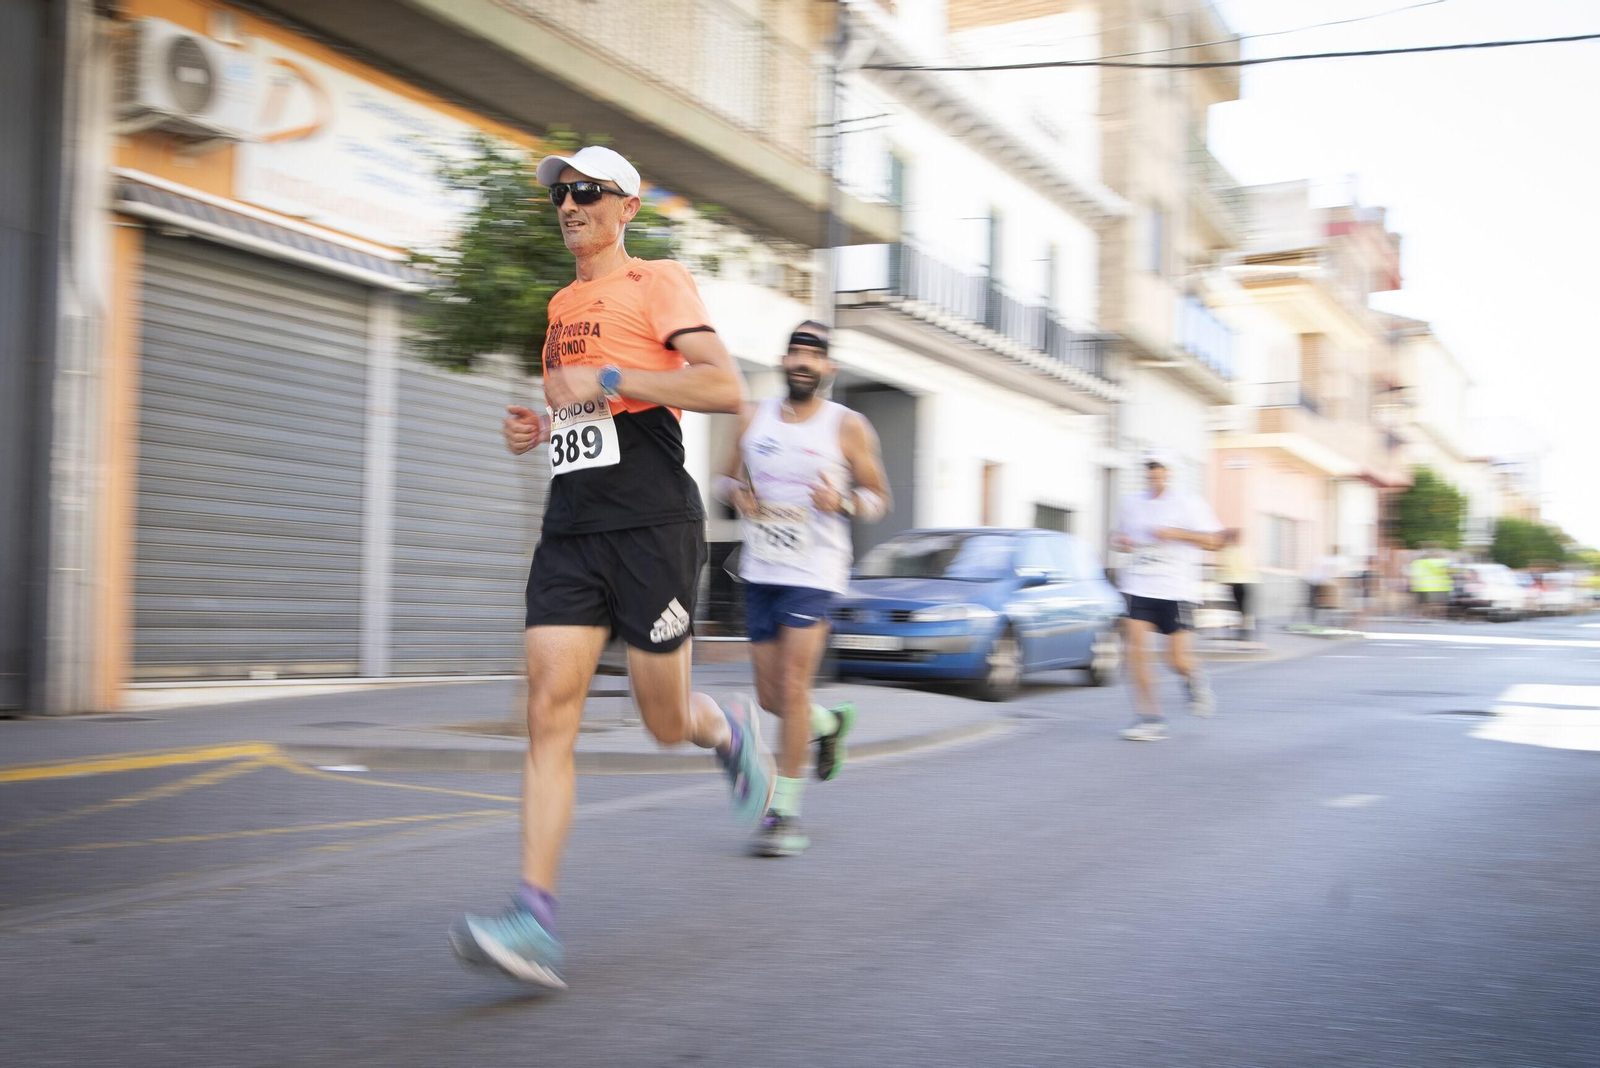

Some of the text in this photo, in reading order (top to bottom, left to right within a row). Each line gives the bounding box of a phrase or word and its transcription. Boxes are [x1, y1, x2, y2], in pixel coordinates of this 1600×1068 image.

[562, 321, 601, 338] PRUEBA
[556, 339, 586, 359] FONDO
[551, 425, 603, 467] 389
